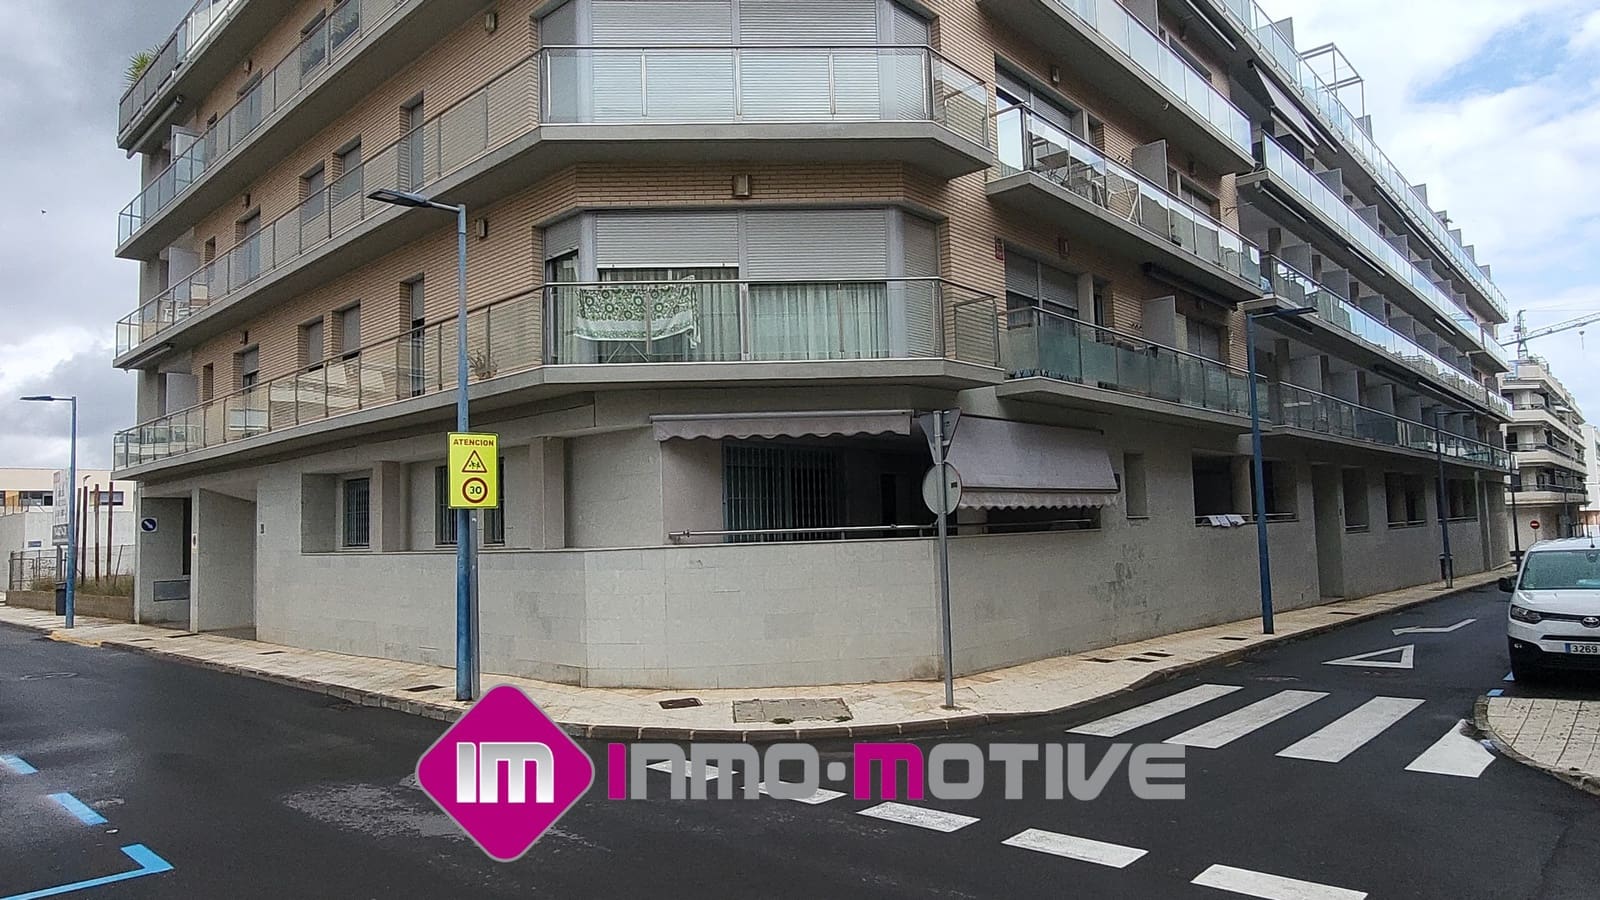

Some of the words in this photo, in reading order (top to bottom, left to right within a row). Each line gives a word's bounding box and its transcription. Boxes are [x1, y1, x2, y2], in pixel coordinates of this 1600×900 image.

[453, 438, 494, 447] ATENCION
[469, 486, 482, 495] 30
[1572, 645, 1598, 654] 3269
